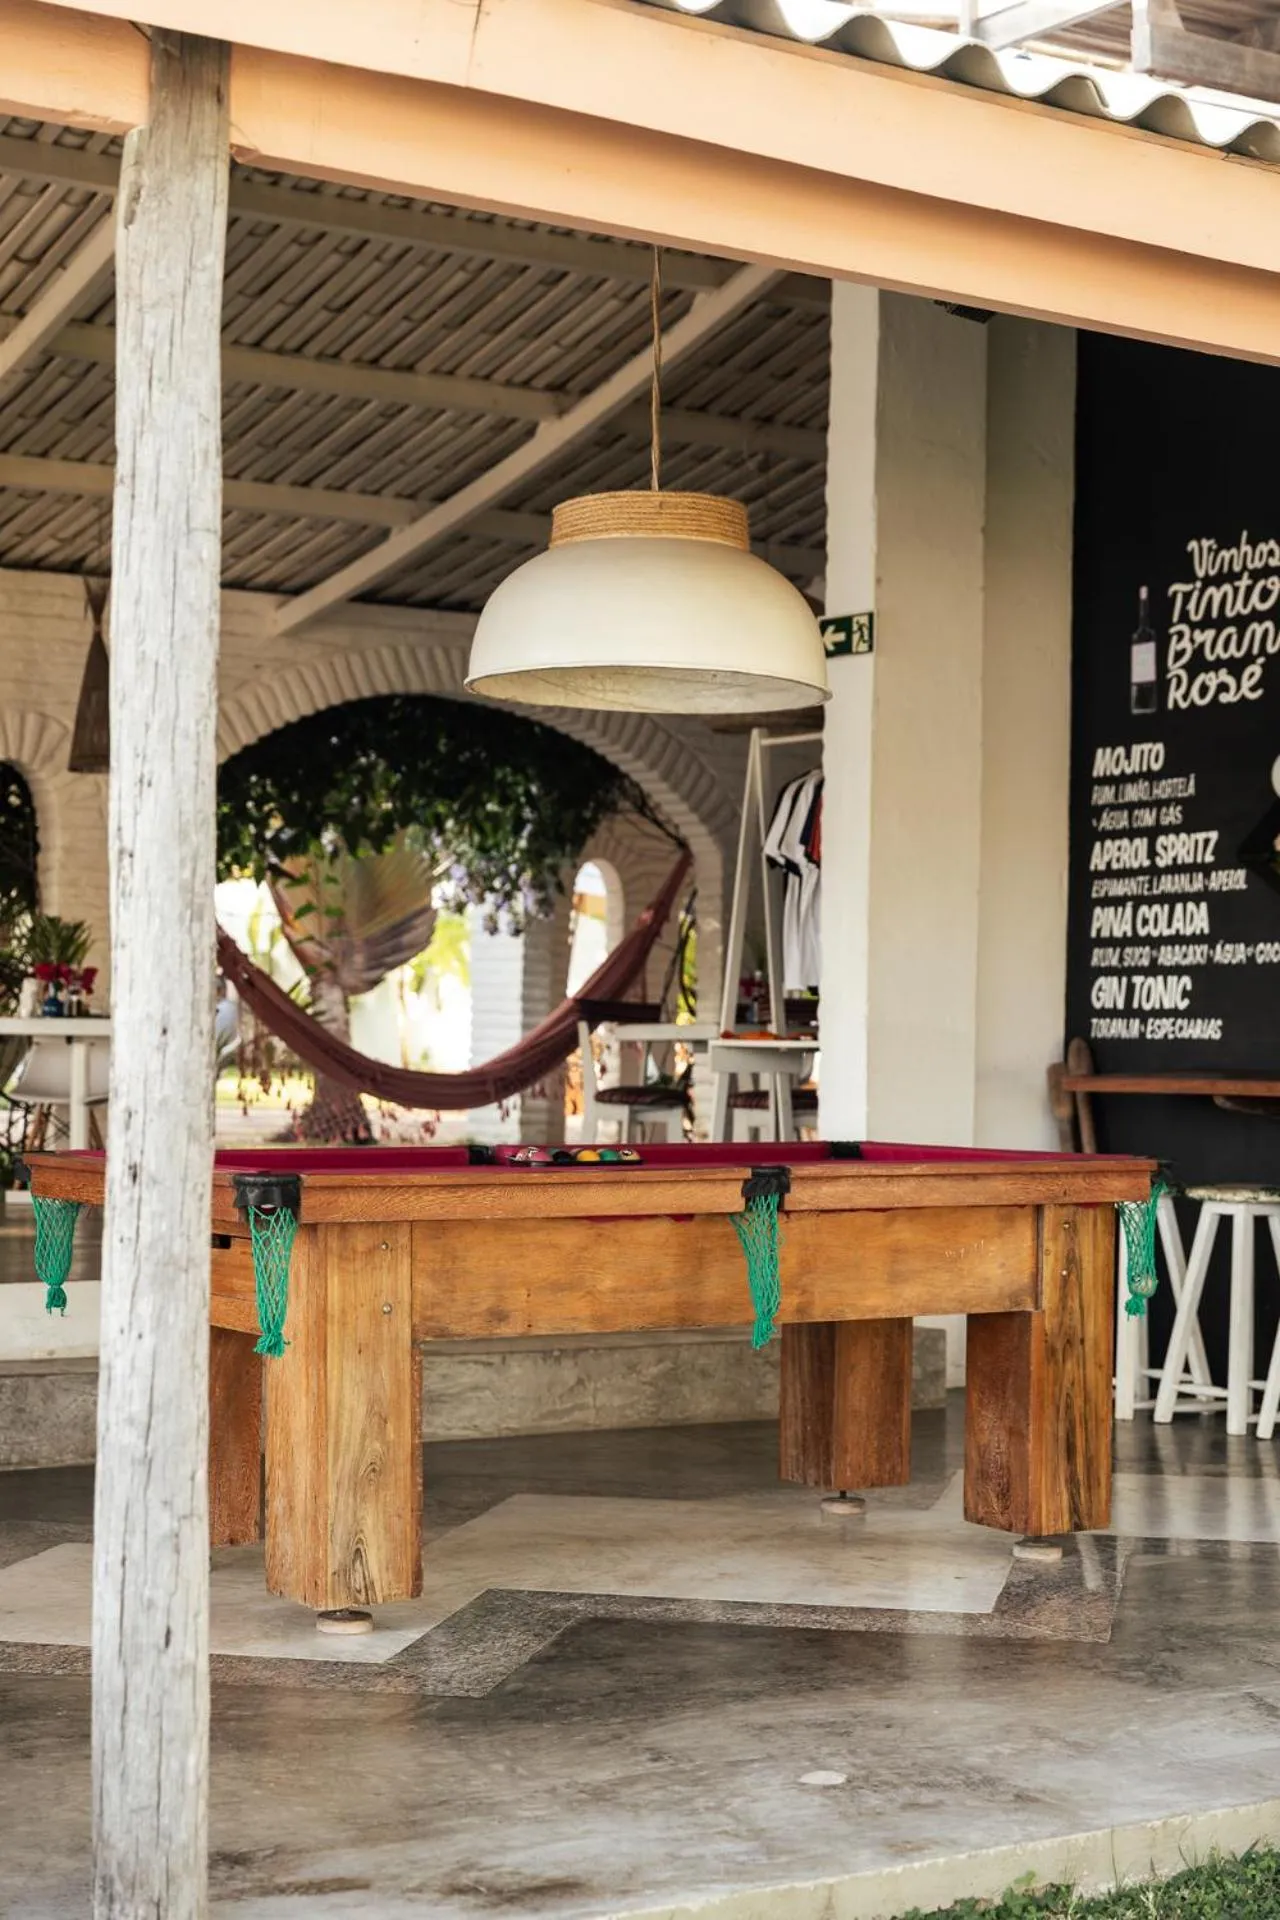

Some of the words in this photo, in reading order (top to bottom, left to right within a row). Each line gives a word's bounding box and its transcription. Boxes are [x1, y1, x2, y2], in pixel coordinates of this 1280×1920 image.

[1166, 657, 1264, 709] Rosé
[1092, 742, 1165, 778] MOJITO
[1090, 837, 1151, 871] APEROL
[1155, 830, 1219, 868] SPRITZ
[1136, 901, 1210, 938] COLADA
[1091, 975, 1128, 1010] GIN
[1131, 975, 1192, 1011] TONIC
